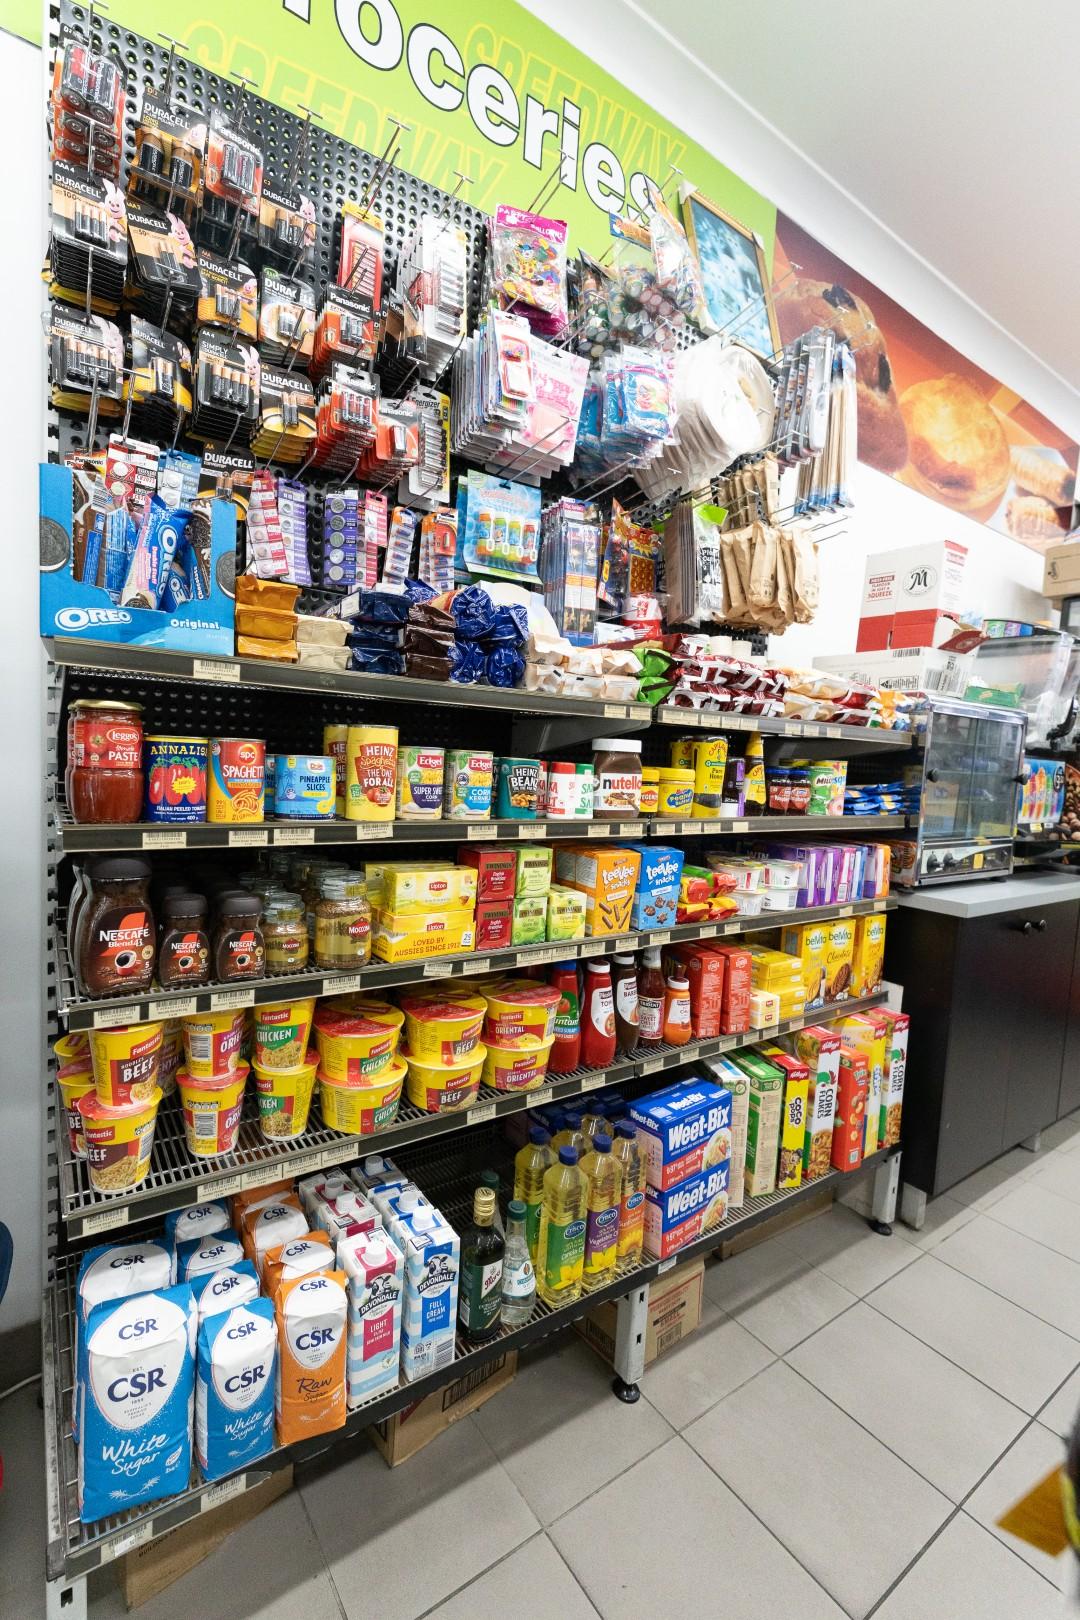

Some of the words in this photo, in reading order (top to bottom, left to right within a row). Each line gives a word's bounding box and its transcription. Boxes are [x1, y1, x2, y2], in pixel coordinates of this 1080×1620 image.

[144, 102, 191, 129] DURACELL
[214, 121, 262, 153] Panasonic
[55, 173, 102, 199] DURACELL
[263, 189, 298, 209] DURACELL
[128, 212, 168, 230] DURACELL
[199, 258, 242, 282] DURACELL
[331, 291, 370, 313] Panasonic
[55, 317, 92, 333] DURACELL
[132, 328, 166, 348] DURACELL
[202, 341, 229, 354] SIMPLY
[262, 373, 310, 392] DURACELL
[204, 453, 255, 469] DURACELL
[57, 609, 131, 629] OREO
[170, 618, 220, 631] Original
[108, 751, 138, 762] PASTE
[240, 751, 256, 761] spc
[366, 745, 395, 757] HEINZ
[300, 775, 330, 784] PINEAPPLE
[367, 768, 380, 777] THE
[515, 768, 538, 777] HEINZ
[306, 783, 326, 791] SLICES
[364, 778, 381, 787] FOR
[382, 778, 394, 787] ALL
[511, 776, 538, 788] BEANZ
[603, 777, 642, 789] nutella
[414, 787, 432, 795] SUPER
[806, 932, 827, 946] belVita
[828, 927, 852, 941] belVita
[867, 926, 884, 937] belVita
[108, 940, 132, 948] Blend
[413, 937, 434, 947] LOVED
[394, 945, 424, 958] AUSSIES
[426, 944, 446, 953] SINCE
[640, 1000, 660, 1008] TRIDENT
[262, 1012, 289, 1021] Fantastic
[500, 1013, 522, 1021] Fantastic
[257, 1029, 292, 1042] CHICKEN
[495, 1026, 525, 1035] ORIENTAL
[132, 1034, 161, 1055] Fantastic
[456, 1040, 474, 1055] BEEF
[121, 1057, 144, 1069] NOODLES
[123, 1055, 155, 1082] BEEF
[361, 1053, 390, 1074] CHICKEN
[447, 1076, 469, 1088] Fantastic
[506, 1069, 537, 1083] ORIENTAL
[896, 1065, 904, 1092] CORN
[441, 1091, 463, 1104] BEEF
[817, 1090, 825, 1119] FLAKES
[824, 1089, 833, 1117] CORN
[69, 1117, 81, 1129] BE
[630, 1108, 660, 1131] Weet-Bix
[668, 1104, 730, 1152] Weet-Bix
[627, 1194, 644, 1208] Crisco
[667, 1169, 728, 1218] Weet-Bix
[187, 1207, 212, 1221] CSR
[264, 1207, 288, 1221] CSR
[598, 1210, 617, 1225] Crisco
[565, 1221, 586, 1236] Crisco
[589, 1232, 612, 1246] Vegetable
[200, 1245, 227, 1260] CSR
[285, 1242, 311, 1257] CSR
[110, 1254, 145, 1270] CSR
[212, 1277, 240, 1296] CSR
[300, 1279, 328, 1292] CSR
[419, 1272, 455, 1292] DEVONDALE
[360, 1291, 398, 1314] DEVONDALE
[428, 1299, 443, 1310] FULL
[426, 1306, 446, 1320] CREAM
[118, 1318, 159, 1341] CSR
[227, 1321, 258, 1340] CSR
[370, 1319, 387, 1333] LIGHT
[296, 1327, 335, 1350] CSR
[107, 1366, 167, 1403] CSR
[224, 1364, 266, 1393] CSR
[297, 1376, 332, 1394] Raw
[304, 1390, 327, 1403] Sugar
[224, 1411, 263, 1435] White
[231, 1423, 256, 1441] Sugar
[102, 1433, 170, 1462] White
[112, 1451, 160, 1477] Sugar
